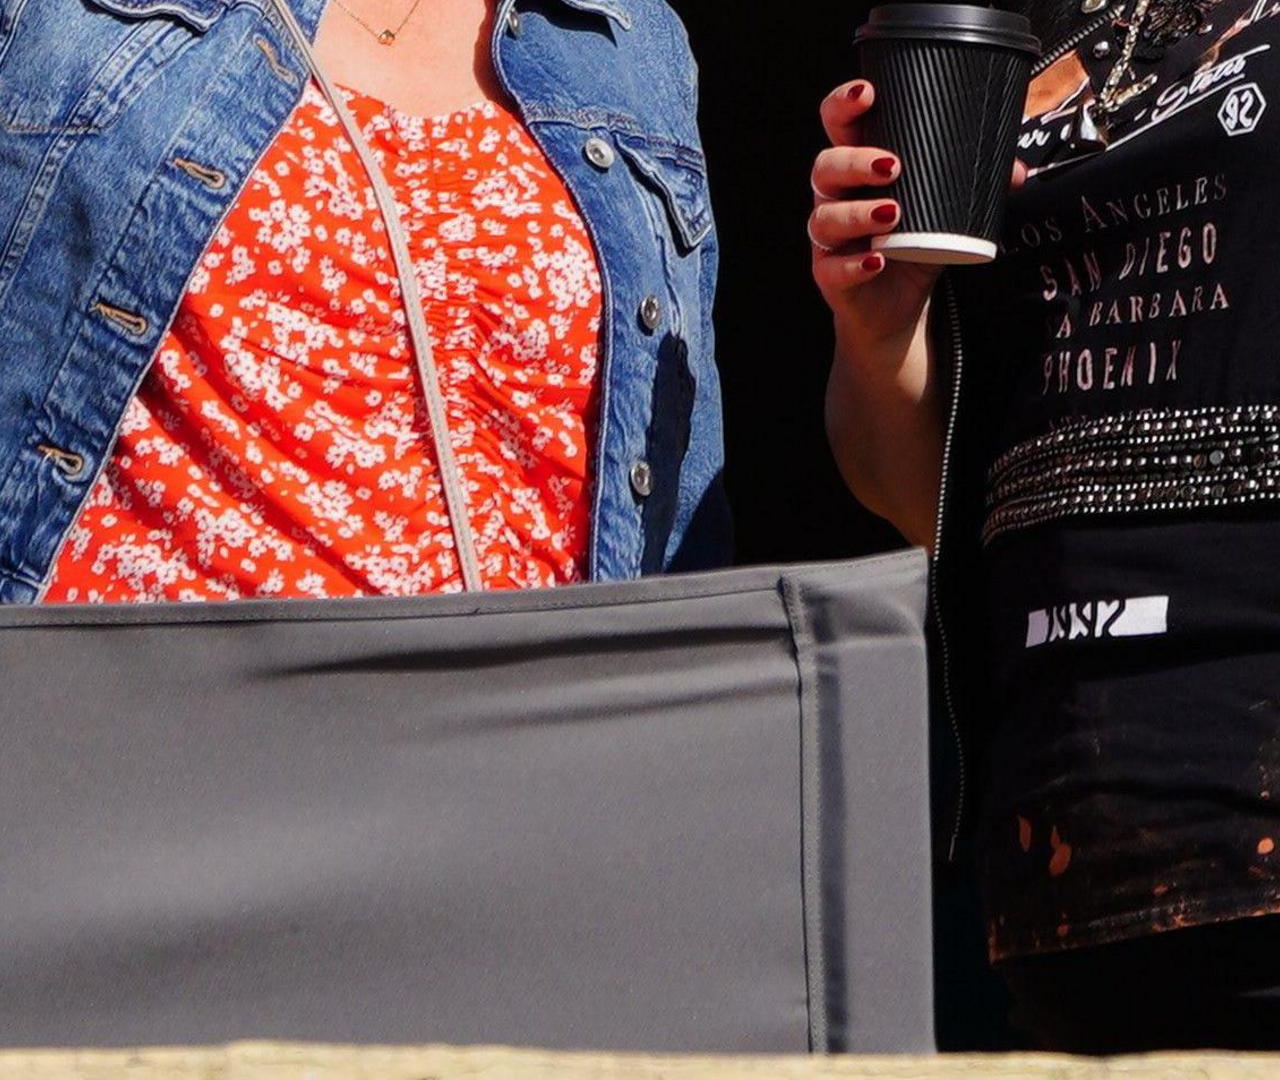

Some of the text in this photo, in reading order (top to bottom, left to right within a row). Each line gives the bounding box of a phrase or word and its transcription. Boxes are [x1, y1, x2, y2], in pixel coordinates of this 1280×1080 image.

[1080, 173, 1228, 233] ANGELES
[1040, 220, 1219, 303] SAN DIEGO
[1088, 282, 1231, 329] BARBARA
[1040, 338, 1183, 396] PHOENIX
